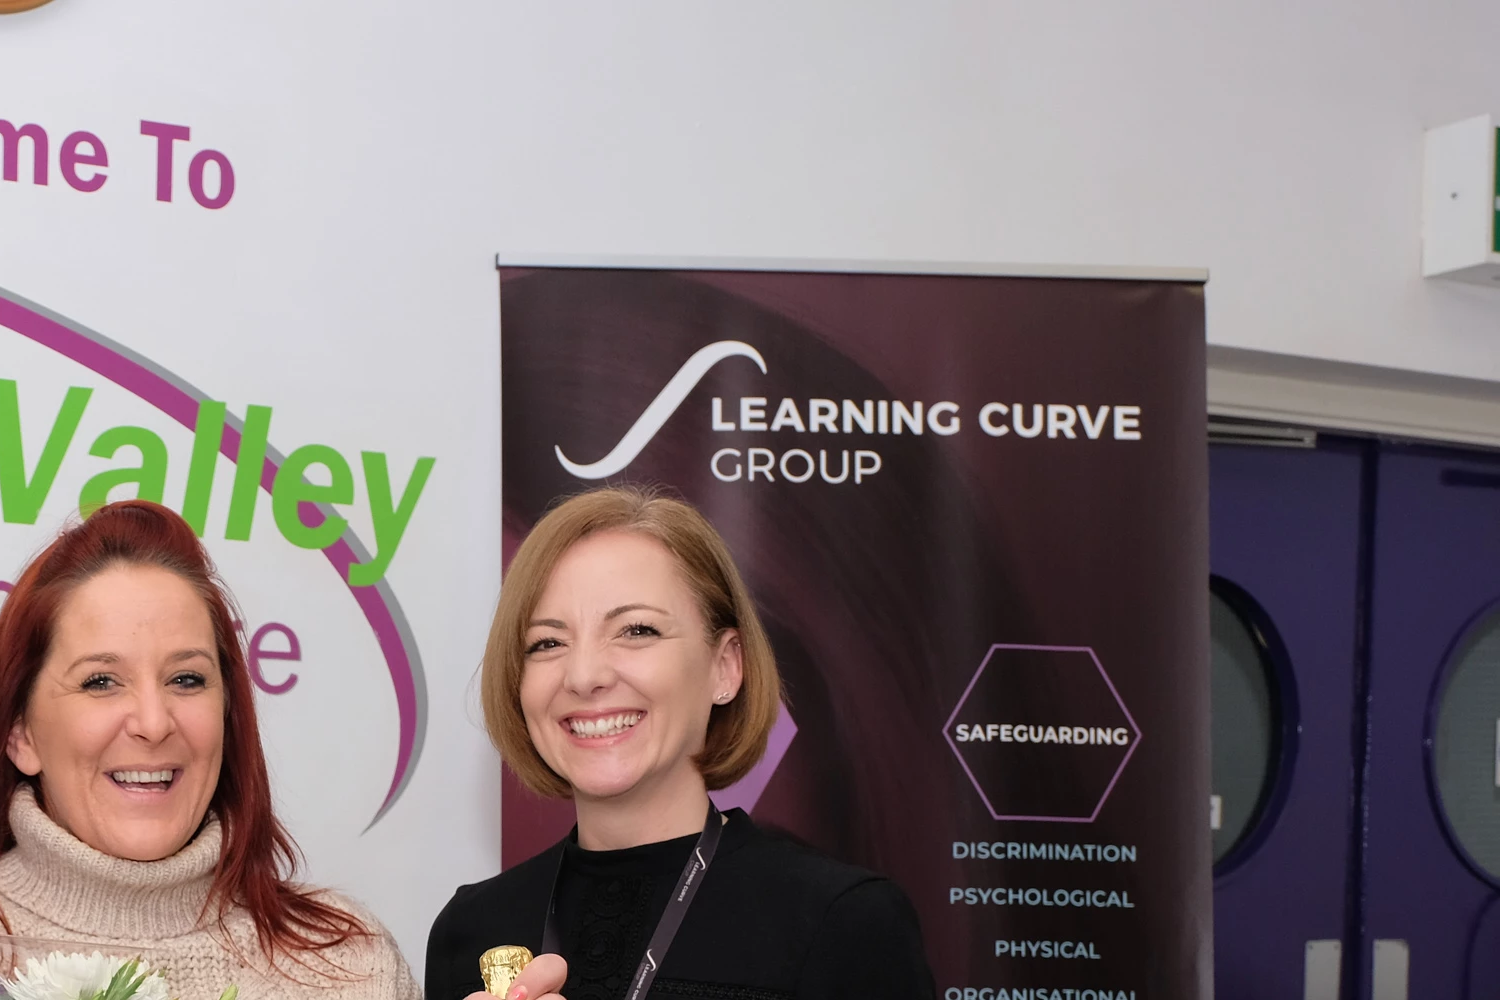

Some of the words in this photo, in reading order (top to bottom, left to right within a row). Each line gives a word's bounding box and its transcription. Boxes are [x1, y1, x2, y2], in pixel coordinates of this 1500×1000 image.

[139, 118, 236, 211] To
[711, 396, 961, 437] LEARNING
[978, 402, 1142, 440] CURVE
[710, 447, 882, 485] GROUP
[955, 723, 1129, 746] SAFEGUARDING
[952, 841, 1137, 863] DISCRIMINATION
[949, 887, 1135, 908] PSYCHOLOGICAL
[994, 939, 1101, 960] PHYSICAL
